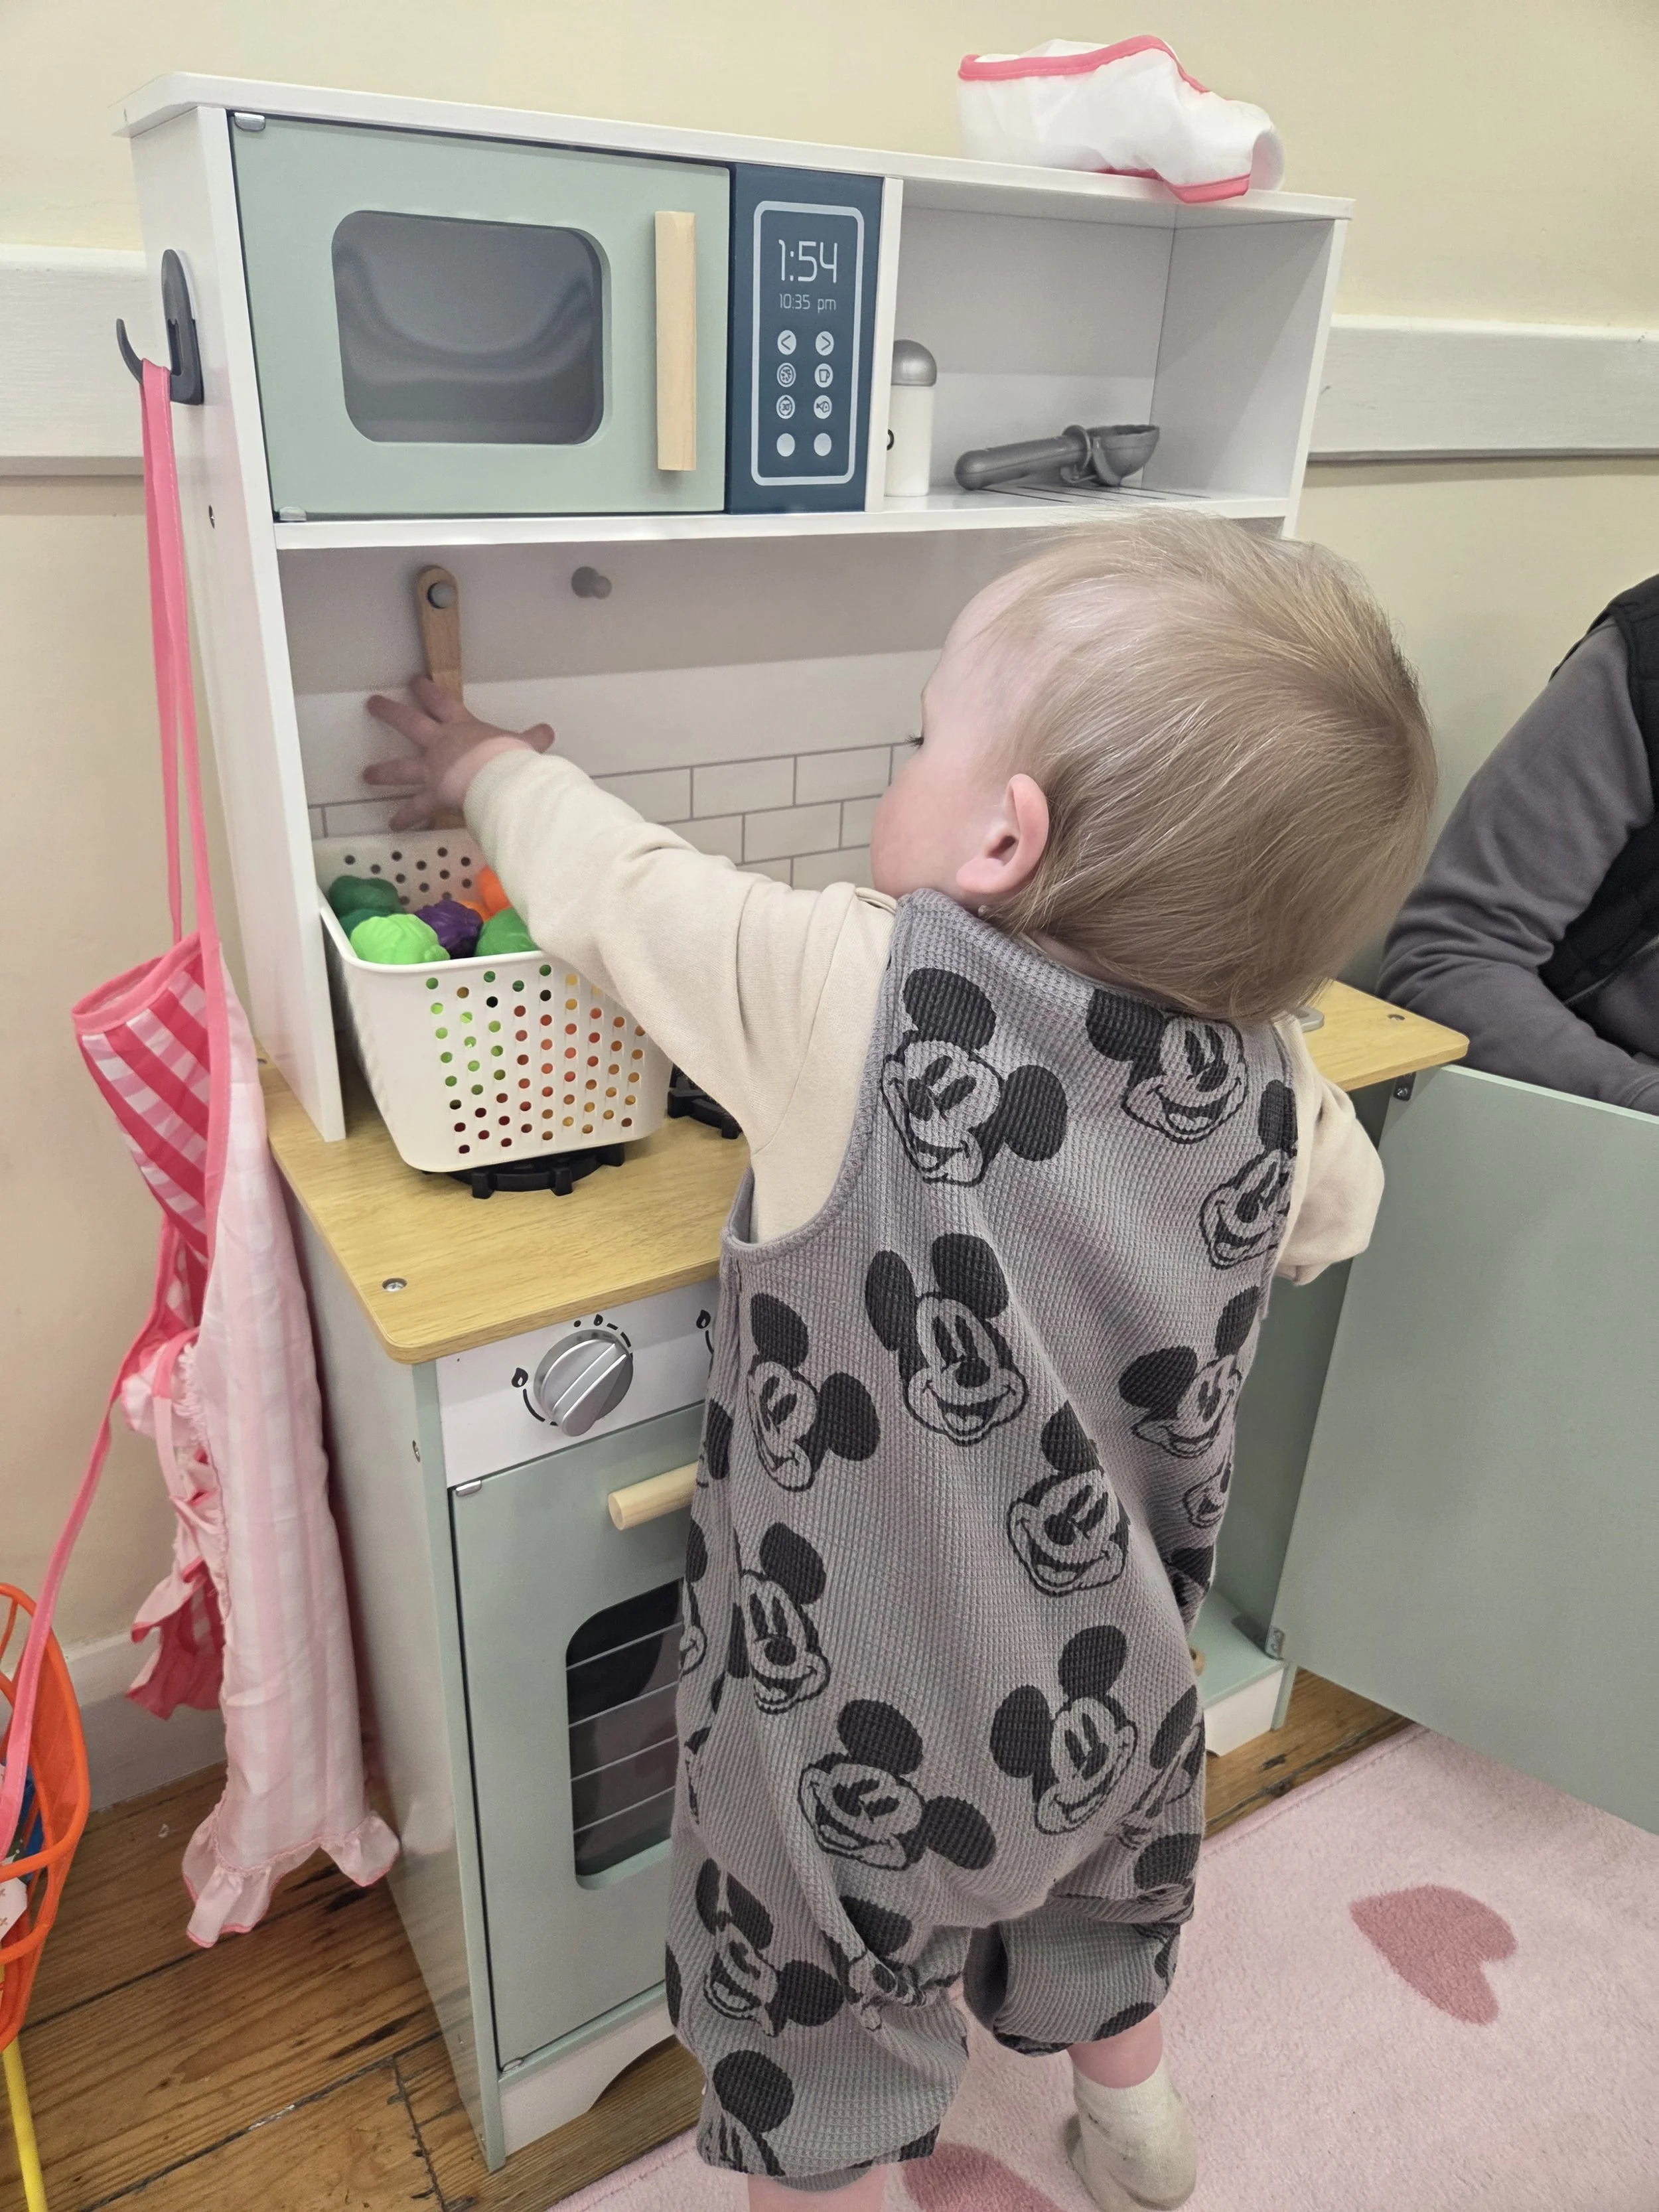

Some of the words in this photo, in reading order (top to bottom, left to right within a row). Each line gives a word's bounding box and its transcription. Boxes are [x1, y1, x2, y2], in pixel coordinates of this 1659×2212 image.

[778, 239, 837, 283] 1:54
[779, 293, 810, 309] 10:35
[818, 298, 836, 314] pm
